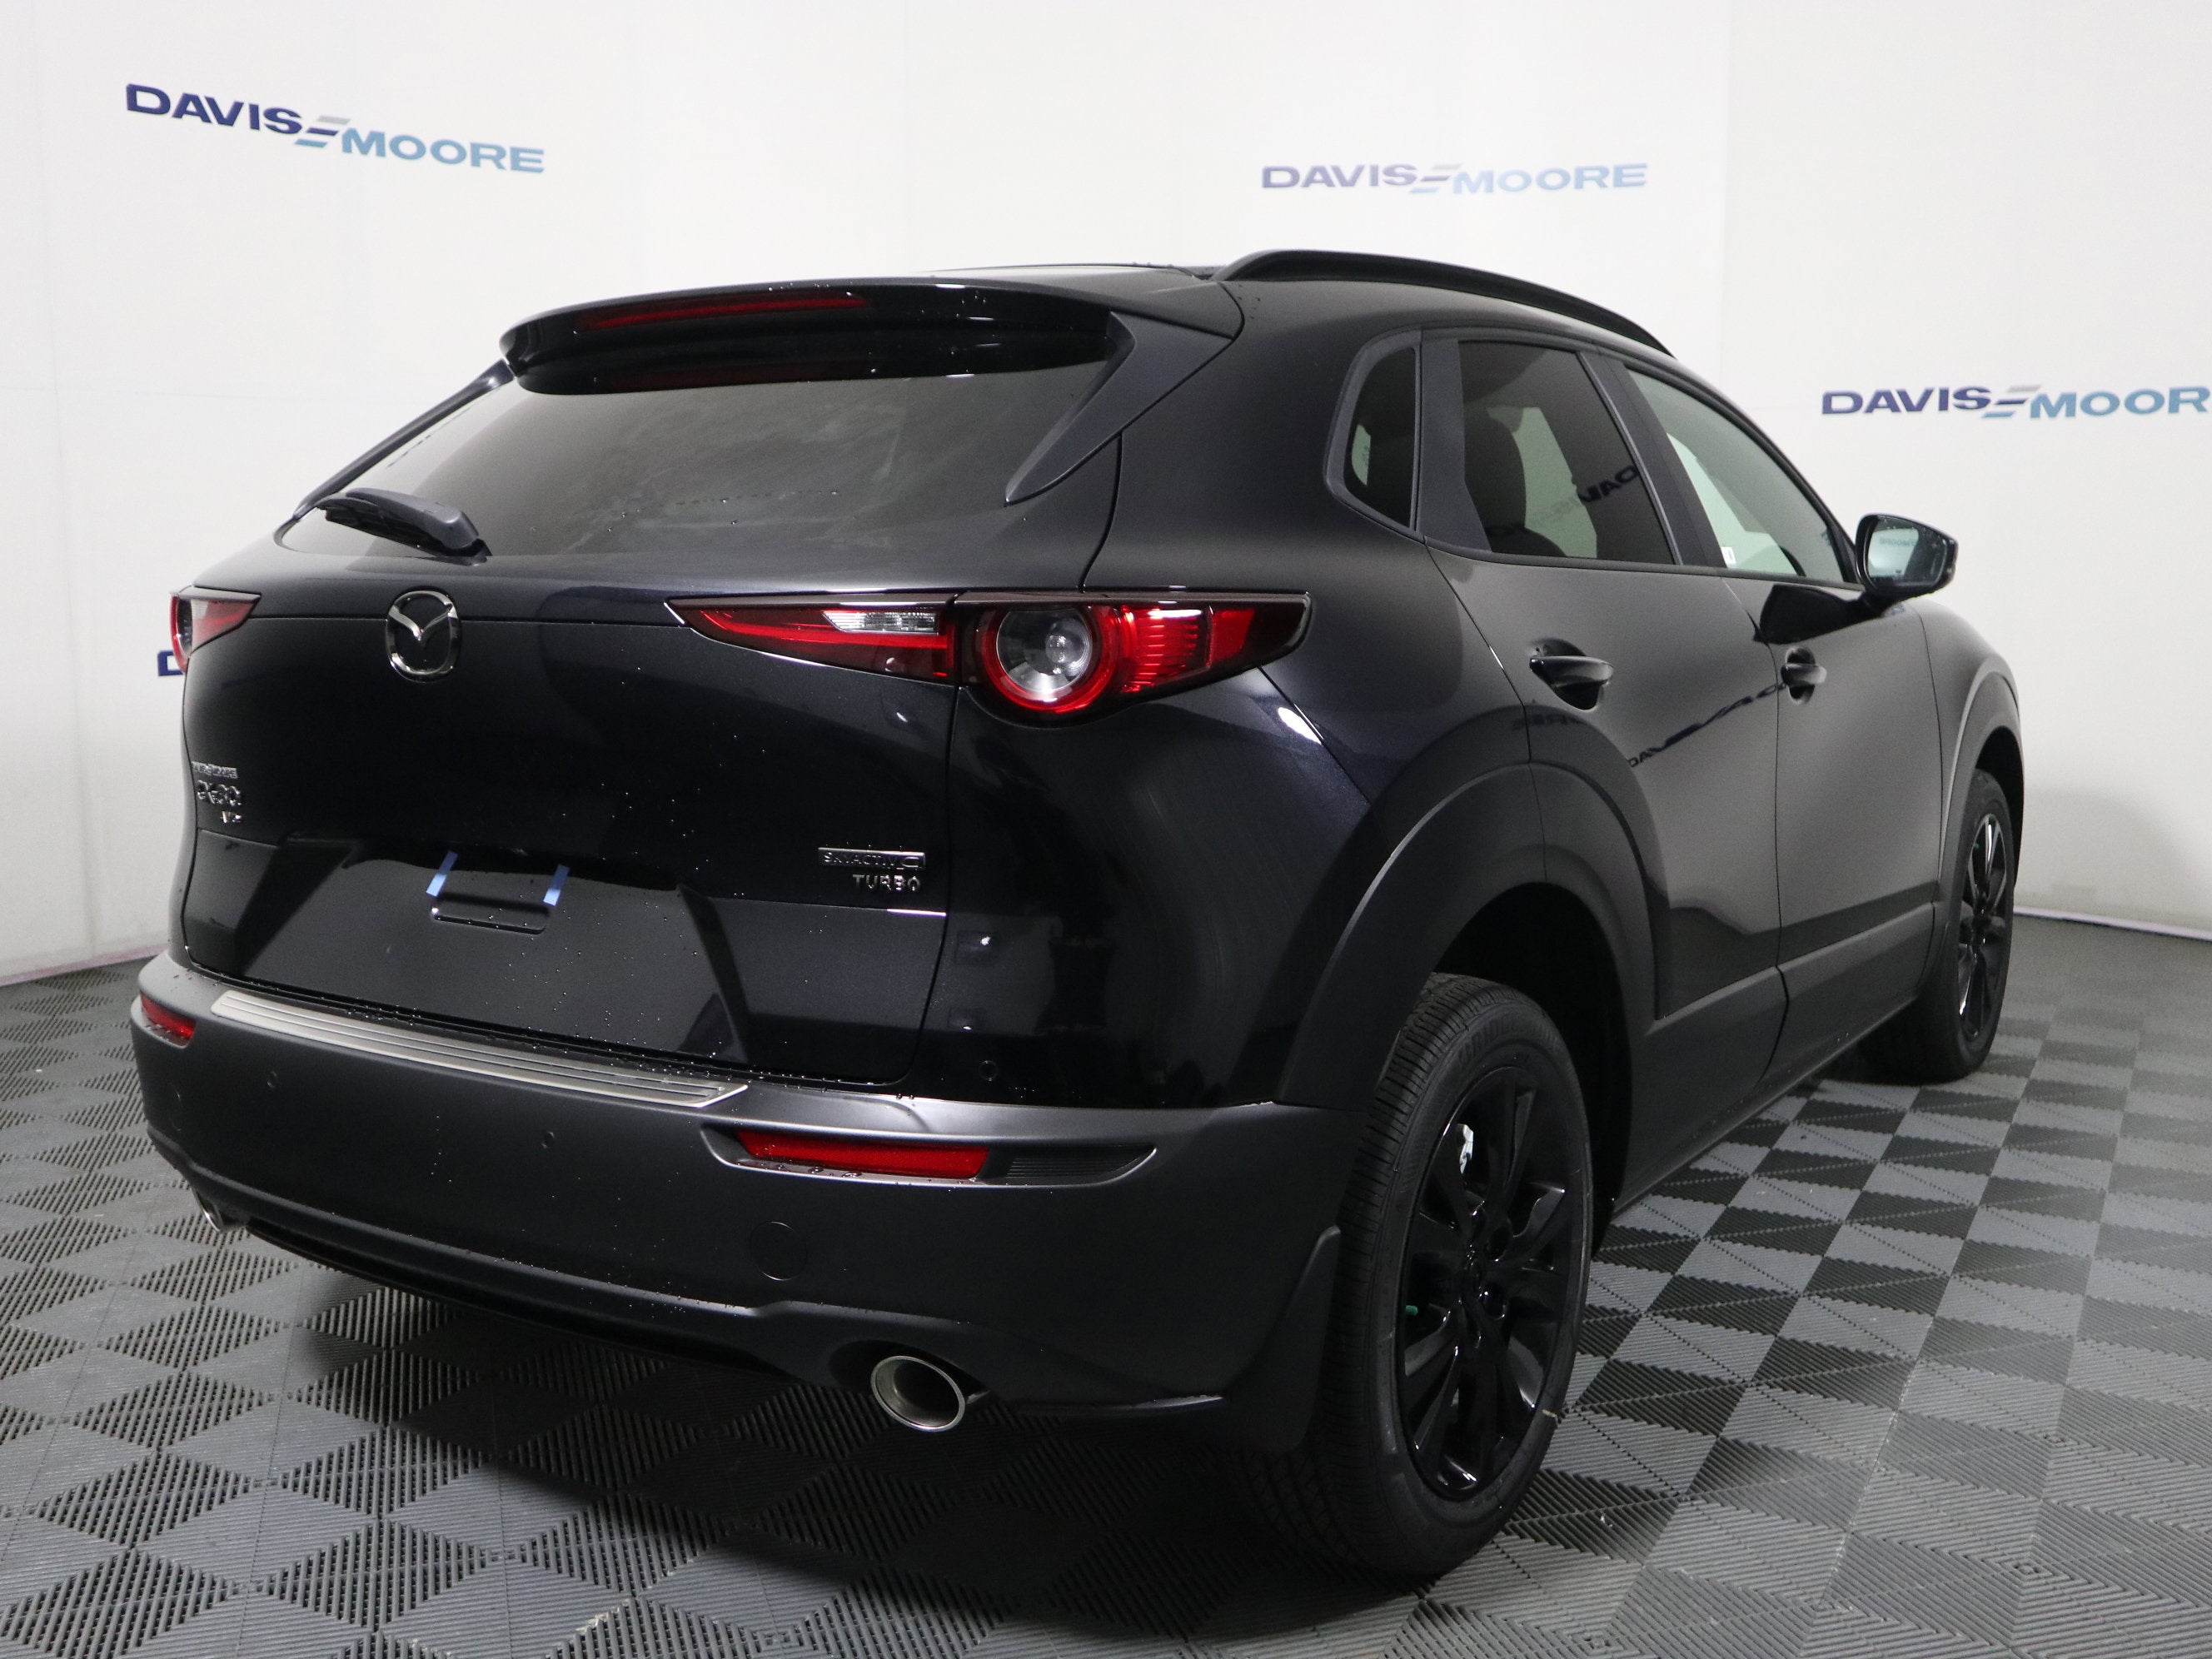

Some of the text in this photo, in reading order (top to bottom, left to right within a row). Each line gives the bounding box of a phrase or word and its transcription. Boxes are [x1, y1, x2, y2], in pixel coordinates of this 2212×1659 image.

[126, 82, 546, 174] DAVIS MOORE
[1260, 162, 1648, 195] DAVIS MOORE
[1821, 385, 1992, 416] DAVIS
[852, 874, 921, 892] TURBO
